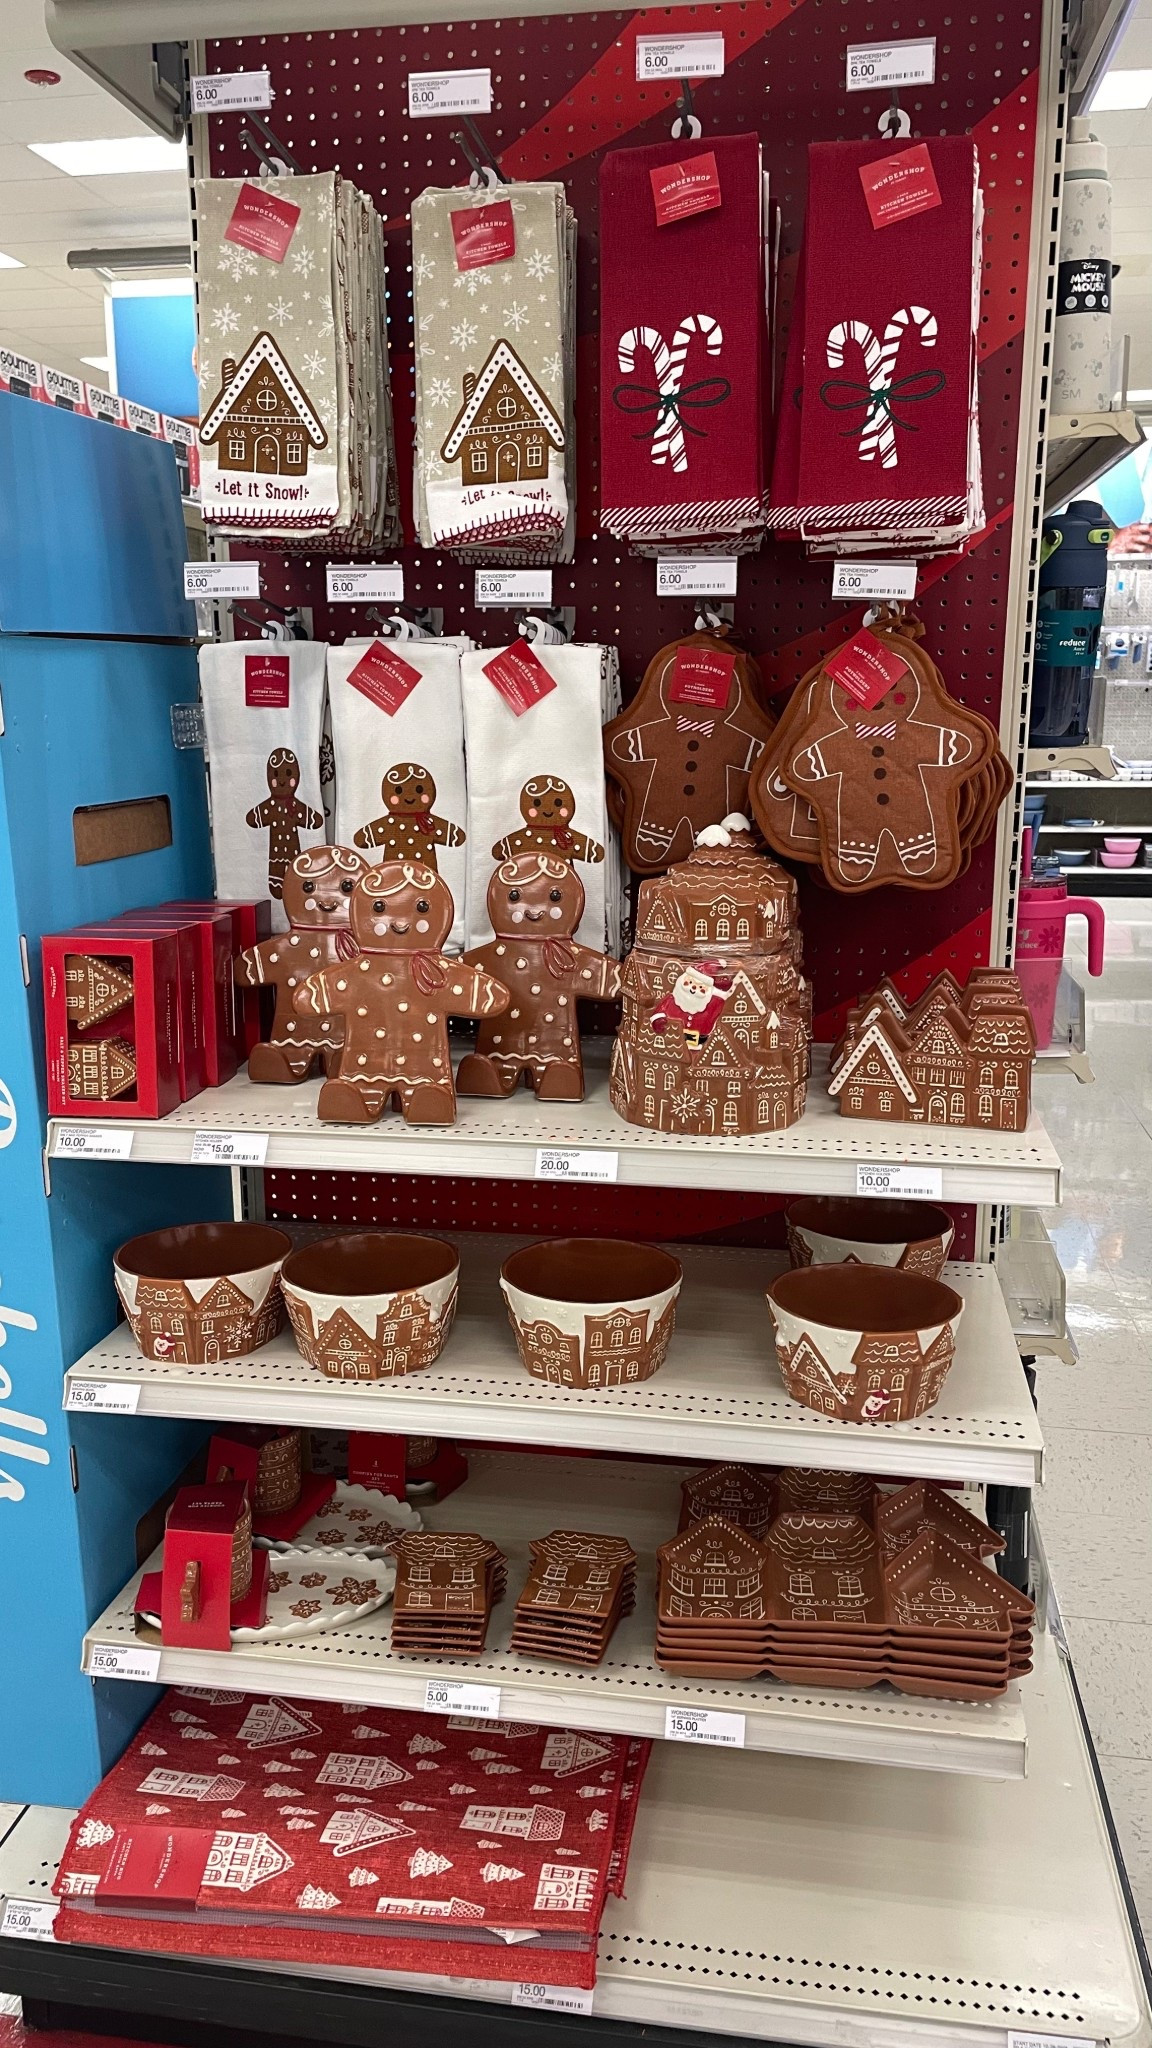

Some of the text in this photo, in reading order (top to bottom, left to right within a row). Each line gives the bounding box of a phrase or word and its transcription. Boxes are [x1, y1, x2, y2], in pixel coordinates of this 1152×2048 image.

[644, 44, 685, 52] WONDERSHOP
[850, 51, 893, 60] WONDERSHOP
[645, 56, 668, 67] 6.00
[851, 64, 875, 77] 6.00
[195, 77, 232, 86] WONDERSHOP
[411, 79, 449, 88] WONDERSHOP
[196, 88, 217, 100] 6.00
[412, 91, 434, 103] 6.00
[660, 175, 711, 194] WONDERSHOP
[872, 167, 925, 191] WONDERSHOP
[243, 204, 289, 229] WONDERSHOP
[460, 221, 508, 236] WONDERSHOP
[1070, 272, 1107, 283] MICKEY
[1071, 281, 1105, 292] MOUSE
[223, 478, 242, 496] Let
[265, 482, 303, 500] Snow!
[467, 489, 485, 505] Let
[187, 578, 207, 587] 6.00
[660, 574, 681, 584] 6.00
[839, 577, 861, 587] 6.00
[332, 582, 353, 592] 6.00
[481, 582, 501, 592] 6.00
[1059, 639, 1086, 647] reduce
[853, 645, 890, 681] WONDERSHOP
[250, 669, 286, 678] WONDERSHOP
[371, 657, 408, 689] WONDERSHOP
[510, 654, 540, 694] WONDERSHOP
[680, 663, 726, 676] WONDERSHOP
[60, 1137, 86, 1147] 10.00
[211, 1144, 234, 1153] 15.00
[540, 1160, 569, 1171] 20.00
[860, 1175, 890, 1186] 10.00
[71, 1391, 96, 1401] 15.00
[94, 1656, 118, 1667] 15.00
[428, 1681, 464, 1689] WONDERSHOP
[427, 1691, 448, 1702] 5.00
[670, 1709, 709, 1718] WONDERSHOP
[671, 1720, 698, 1732] 15.00
[116, 1838, 133, 1880] KITCHEN RUG
[154, 1835, 173, 1888] WONDERSHOP
[7, 1904, 42, 1912] WONDERSHOP
[6, 1914, 31, 1926] 15.00
[518, 1984, 546, 1996] 15.00
